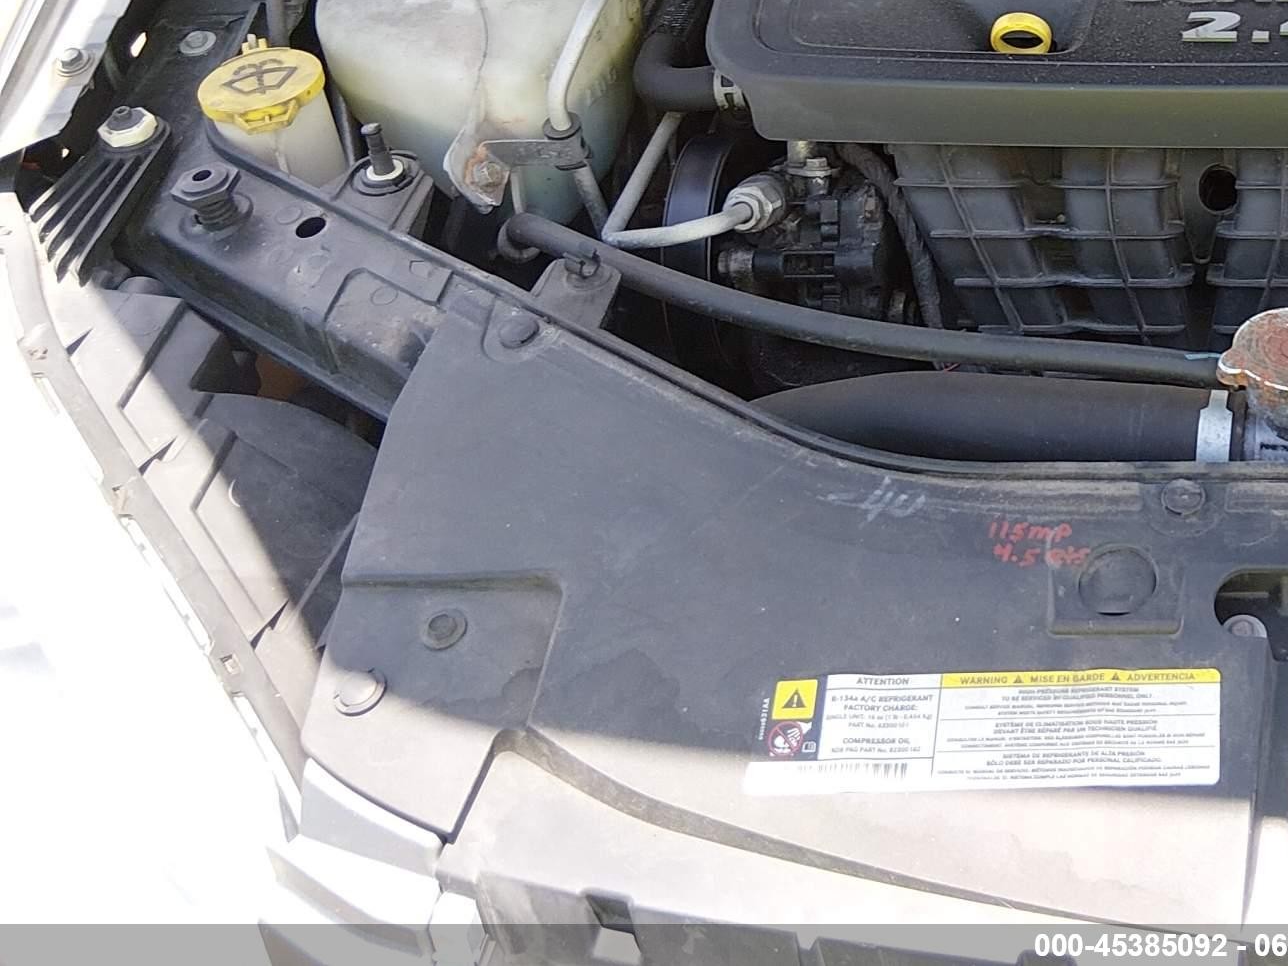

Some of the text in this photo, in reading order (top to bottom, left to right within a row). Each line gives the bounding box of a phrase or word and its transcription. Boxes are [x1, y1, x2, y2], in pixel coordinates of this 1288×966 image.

[855, 677, 910, 686] ATTENTION
[959, 672, 1195, 685] WARNING MISE EN GARDE ADVERTENCIA
[860, 695, 877, 703] A/C
[879, 694, 934, 703] REFRIGERANT
[843, 704, 881, 712] FACTORY
[843, 737, 911, 745] COMPRESSOR OIL
